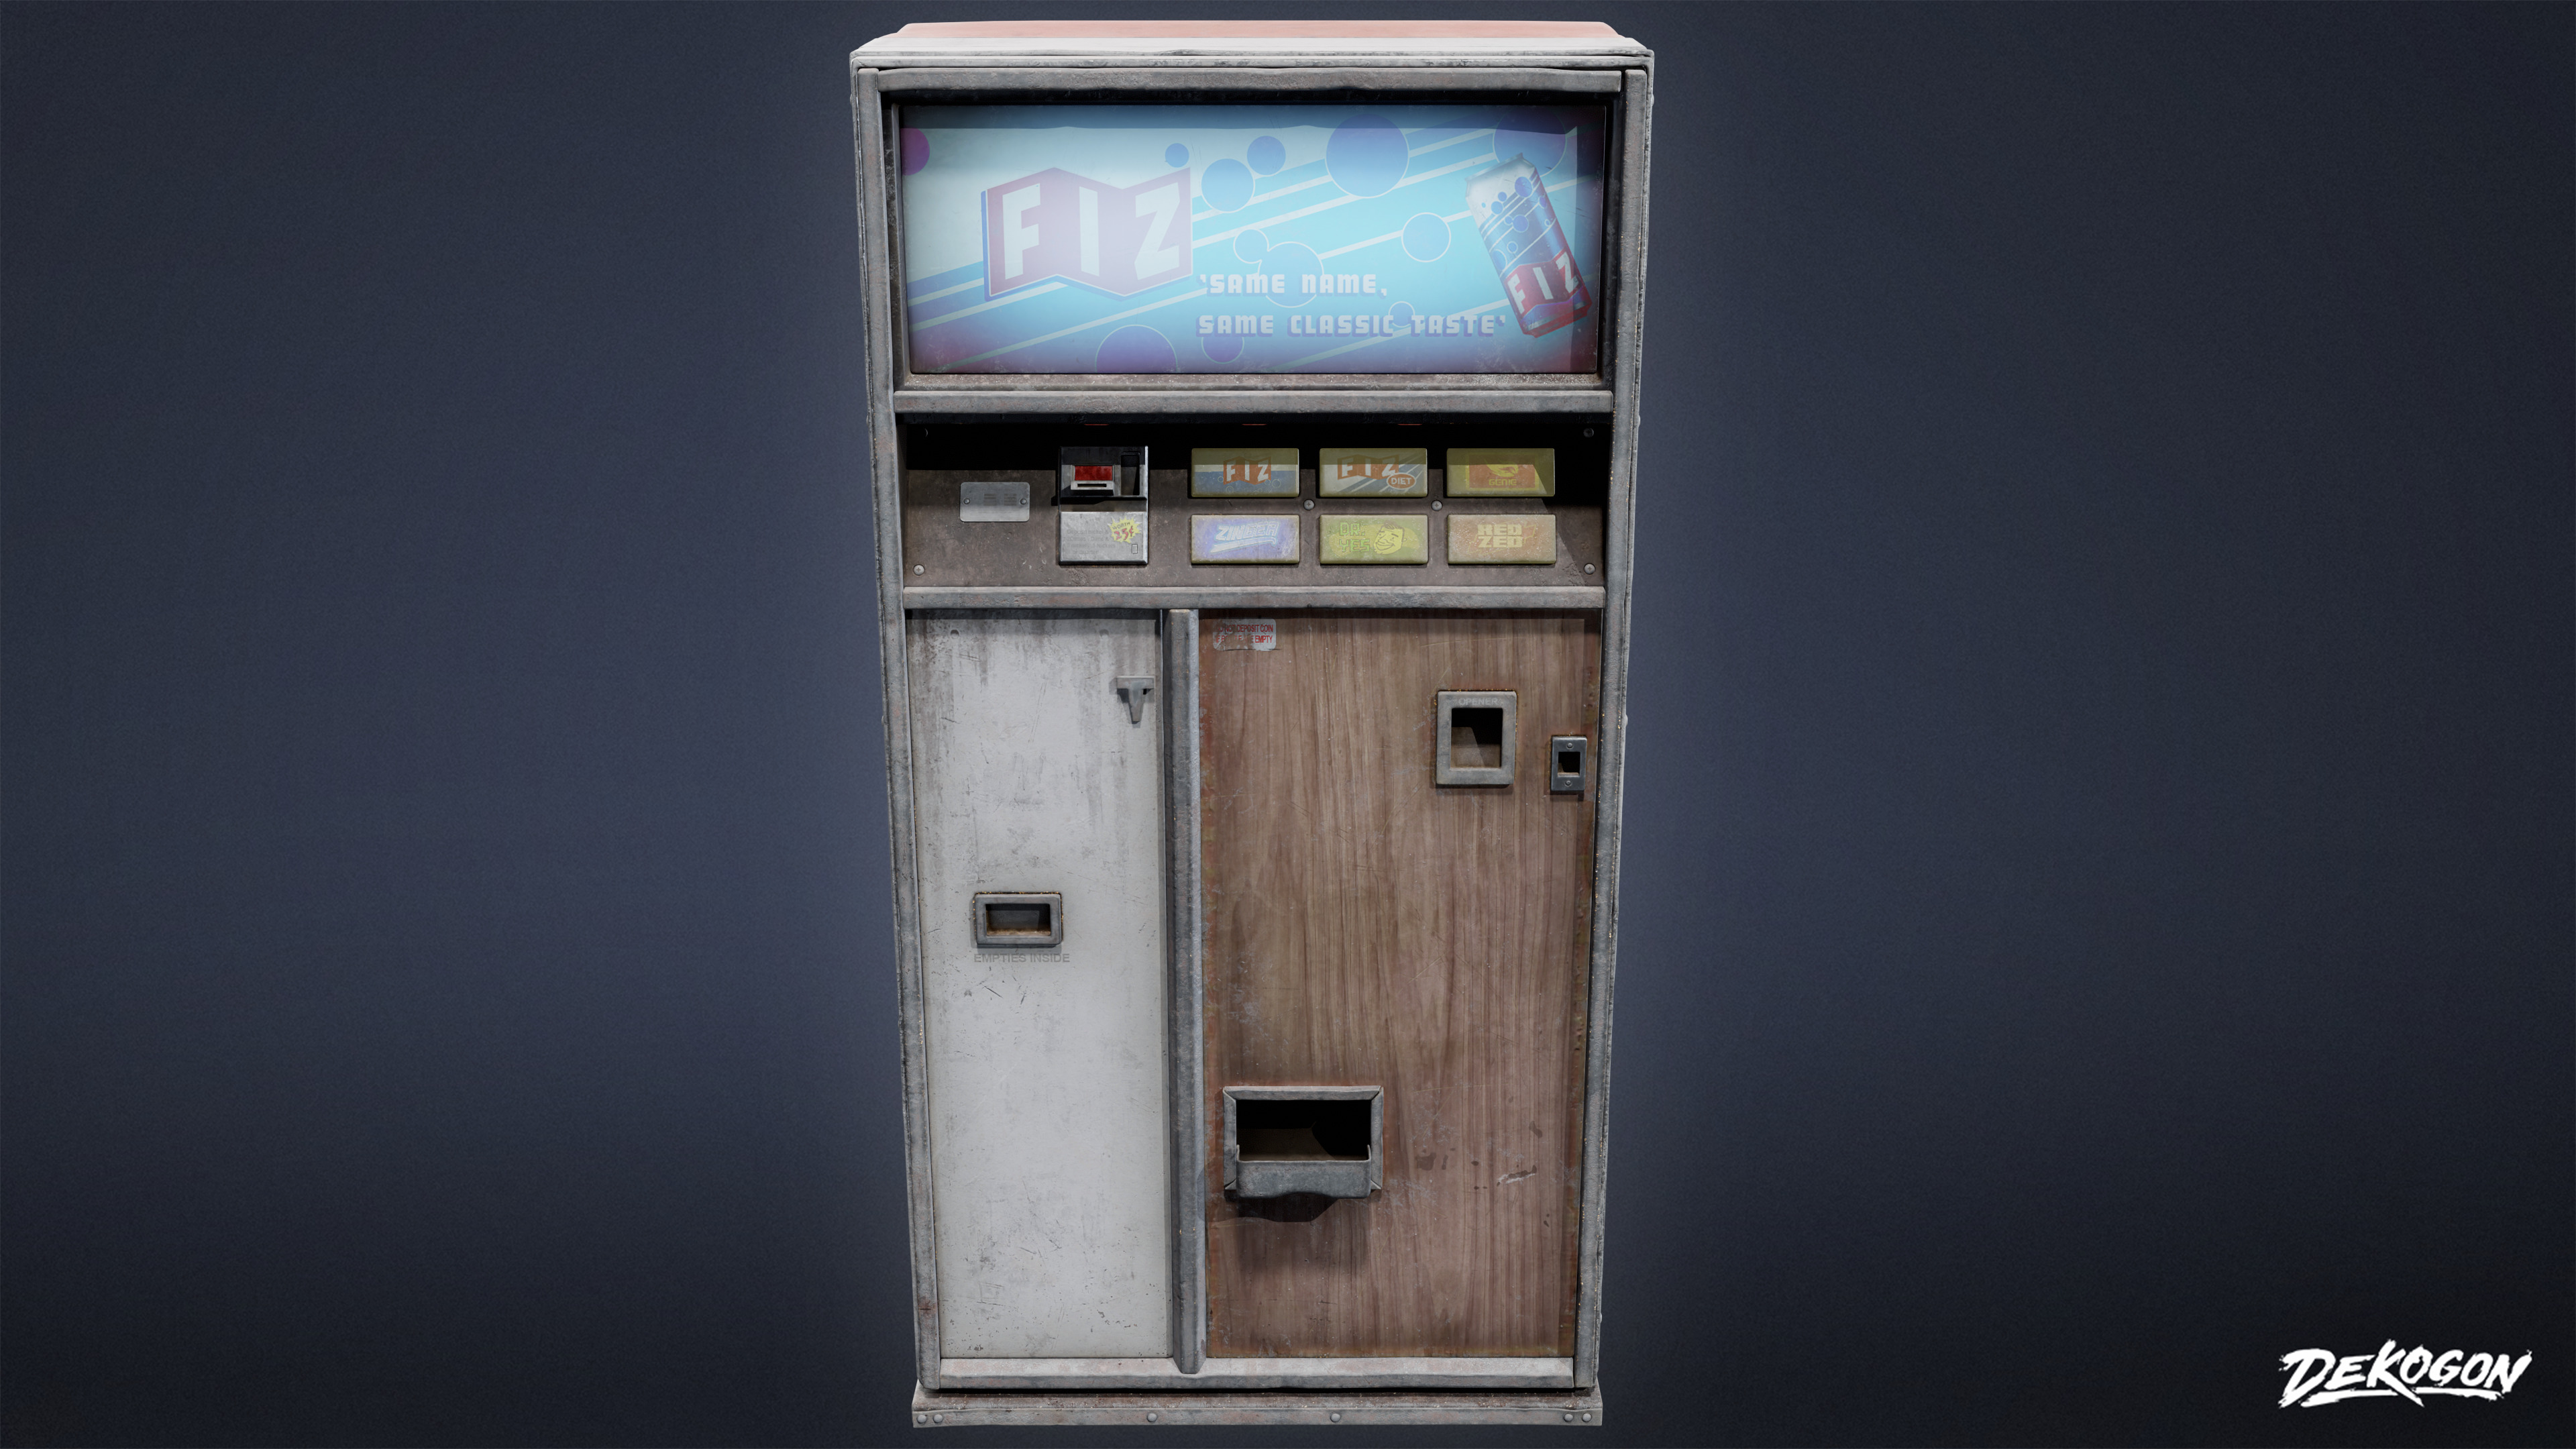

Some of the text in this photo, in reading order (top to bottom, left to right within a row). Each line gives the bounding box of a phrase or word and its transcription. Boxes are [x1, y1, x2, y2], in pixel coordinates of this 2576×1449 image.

[1002, 182, 1181, 280] FIZ
[1300, 274, 1388, 297] NAME,
[1507, 251, 1580, 315] FIZ
[1197, 315, 1274, 335] SAME
[1289, 315, 1394, 335] CLASSIC
[1226, 459, 1269, 482] FIZ
[1342, 457, 1396, 478] FIZ
[1391, 477, 1412, 485] DIET
[1489, 478, 1517, 486] GENIE
[1215, 521, 1279, 541] ZINGER
[1340, 522, 1365, 537] DR.
[1477, 524, 1523, 535] RED
[1339, 539, 1371, 552] YES
[1478, 536, 1523, 548] ZED
[1236, 624, 1260, 632] DEPOSIT
[1260, 624, 1273, 632] COIN
[1255, 635, 1273, 643] EMPTY
[1458, 698, 1498, 706] OPENER
[974, 953, 1070, 963] EMPTIES INSIDE
